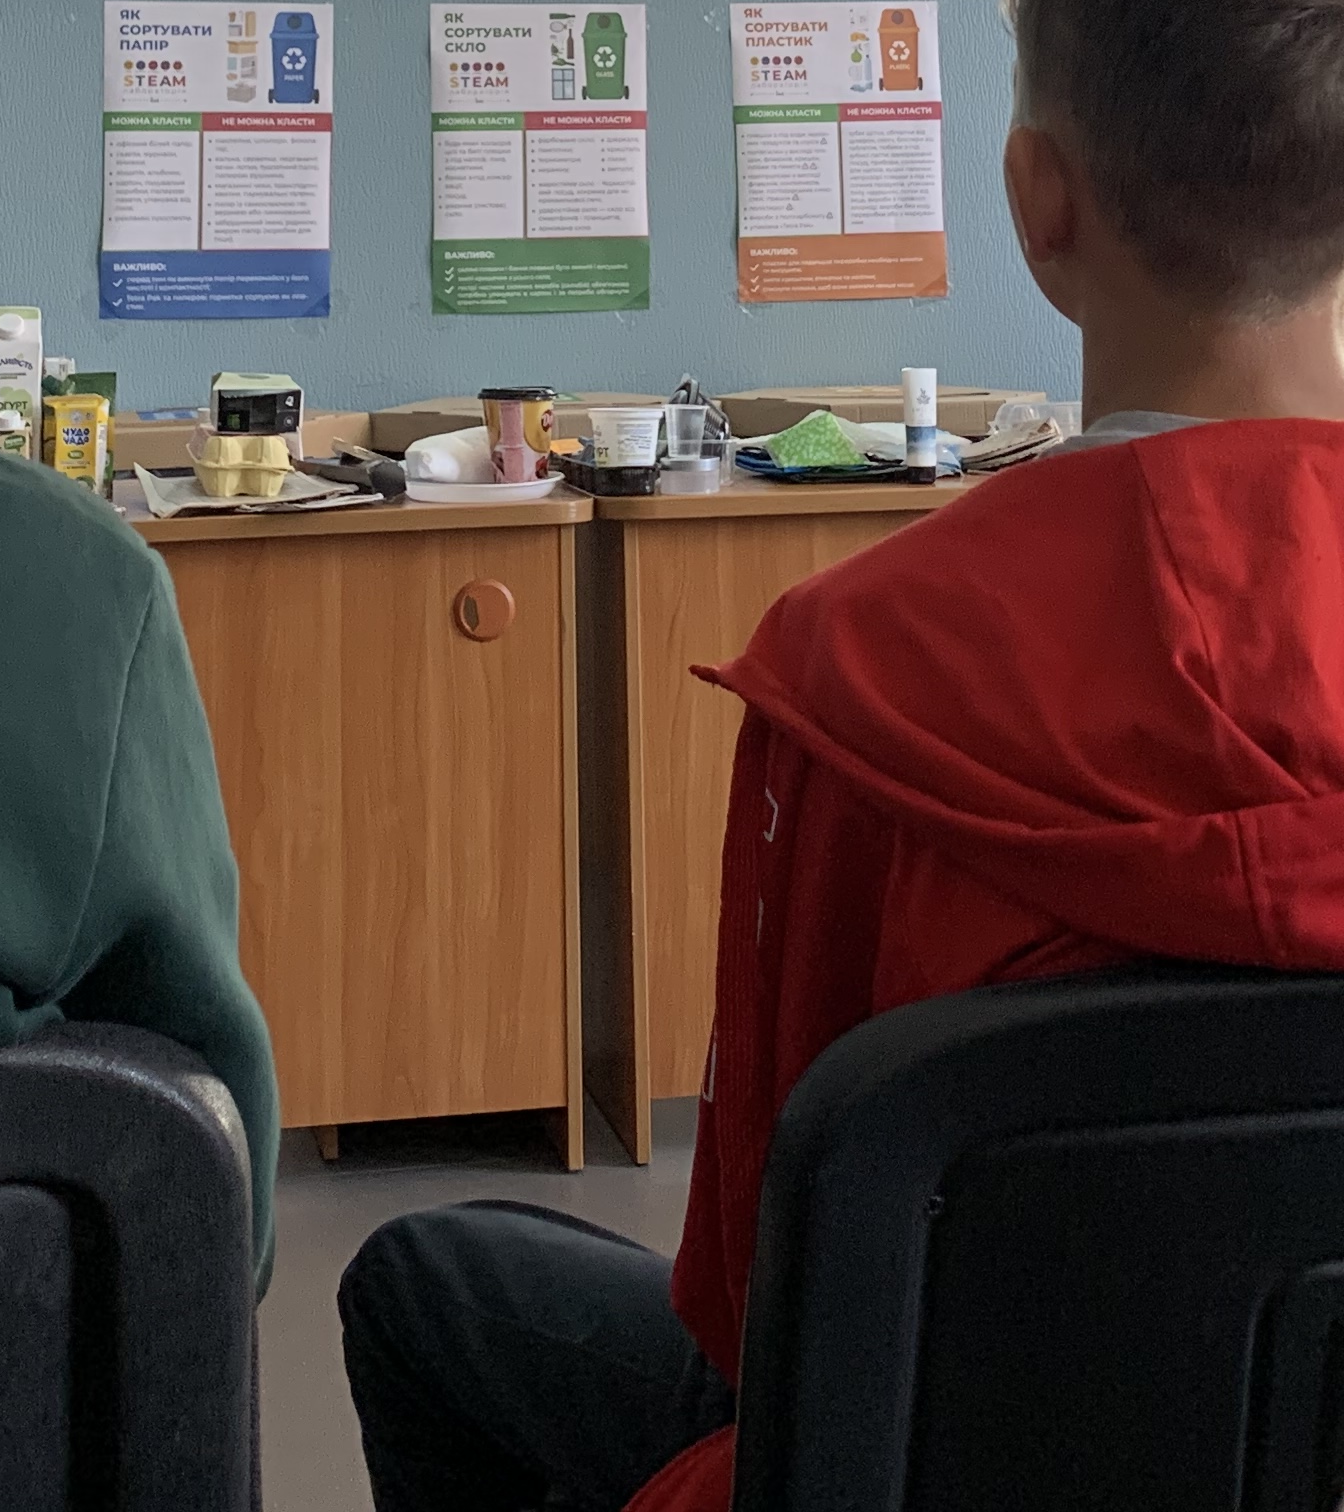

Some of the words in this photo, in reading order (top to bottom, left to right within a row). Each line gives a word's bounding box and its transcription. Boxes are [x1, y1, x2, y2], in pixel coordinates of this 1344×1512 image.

[120, 10, 140, 20] ЯК
[444, 14, 464, 23] ЯК
[744, 9, 762, 18] ЯК
[120, 25, 212, 36] СОРТУВАТИ
[745, 22, 827, 32] СОРТУВАТИ
[444, 28, 531, 38] СОРТУВАТИ
[120, 40, 169, 50] ПАПІР
[745, 37, 812, 47] ПЛАСТИК
[445, 43, 486, 52] СКЛО
[124, 75, 186, 86] STEAM
[751, 70, 807, 81] STEAM
[450, 76, 509, 87] STEAM
[63, 427, 90, 436] ЧУДО
